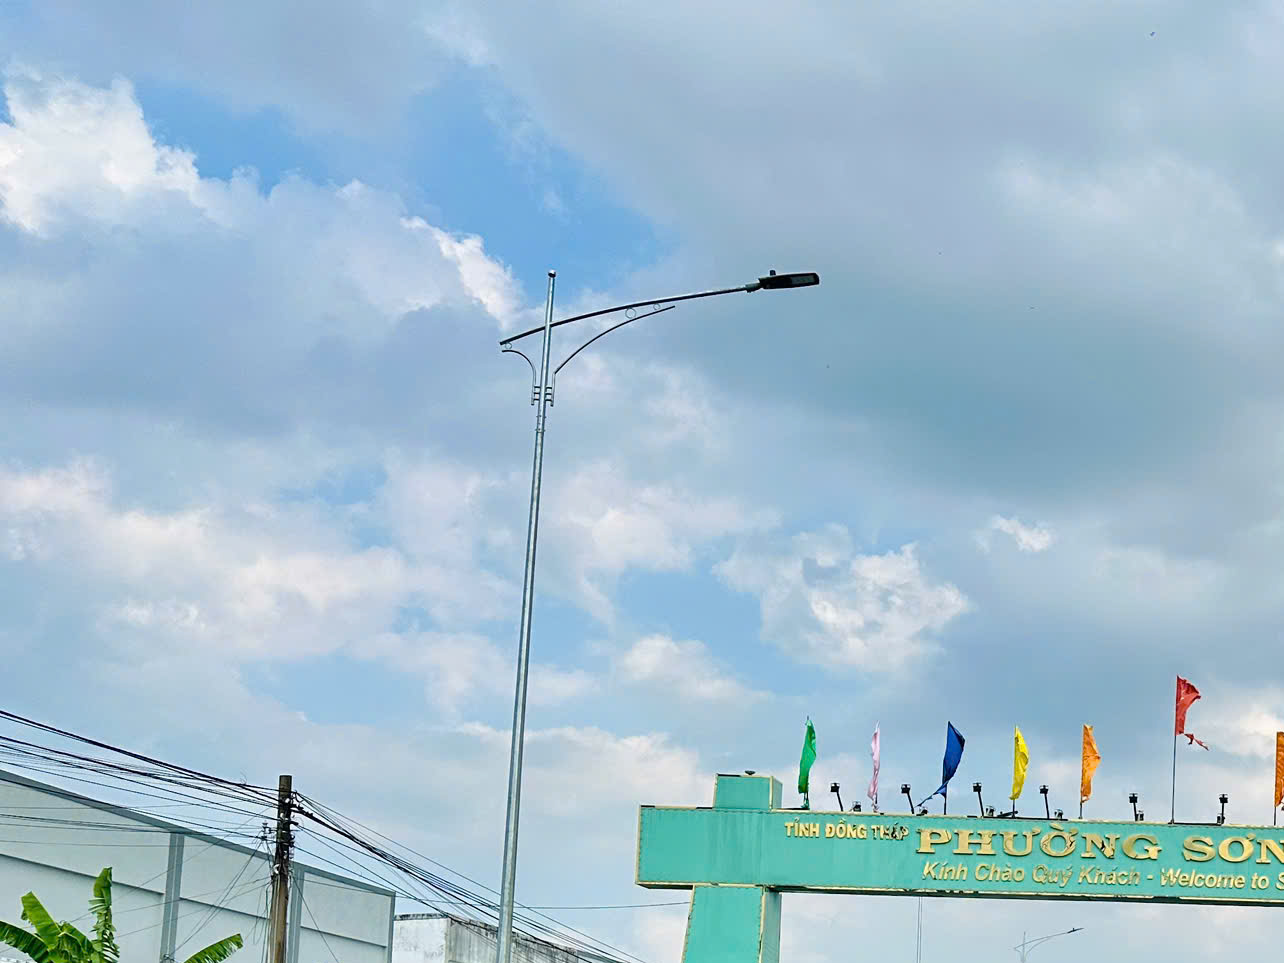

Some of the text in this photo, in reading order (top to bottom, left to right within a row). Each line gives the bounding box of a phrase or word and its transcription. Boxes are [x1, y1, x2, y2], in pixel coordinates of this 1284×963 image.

[825, 817, 868, 839] ĐỒNG
[915, 823, 1163, 860] PHƯỜNG
[922, 861, 968, 882] Kính
[974, 863, 1026, 882] Chào
[1031, 864, 1073, 888] Quý
[1078, 864, 1141, 885] Khách
[1160, 867, 1246, 890] Welcome
[1251, 871, 1270, 890] to
